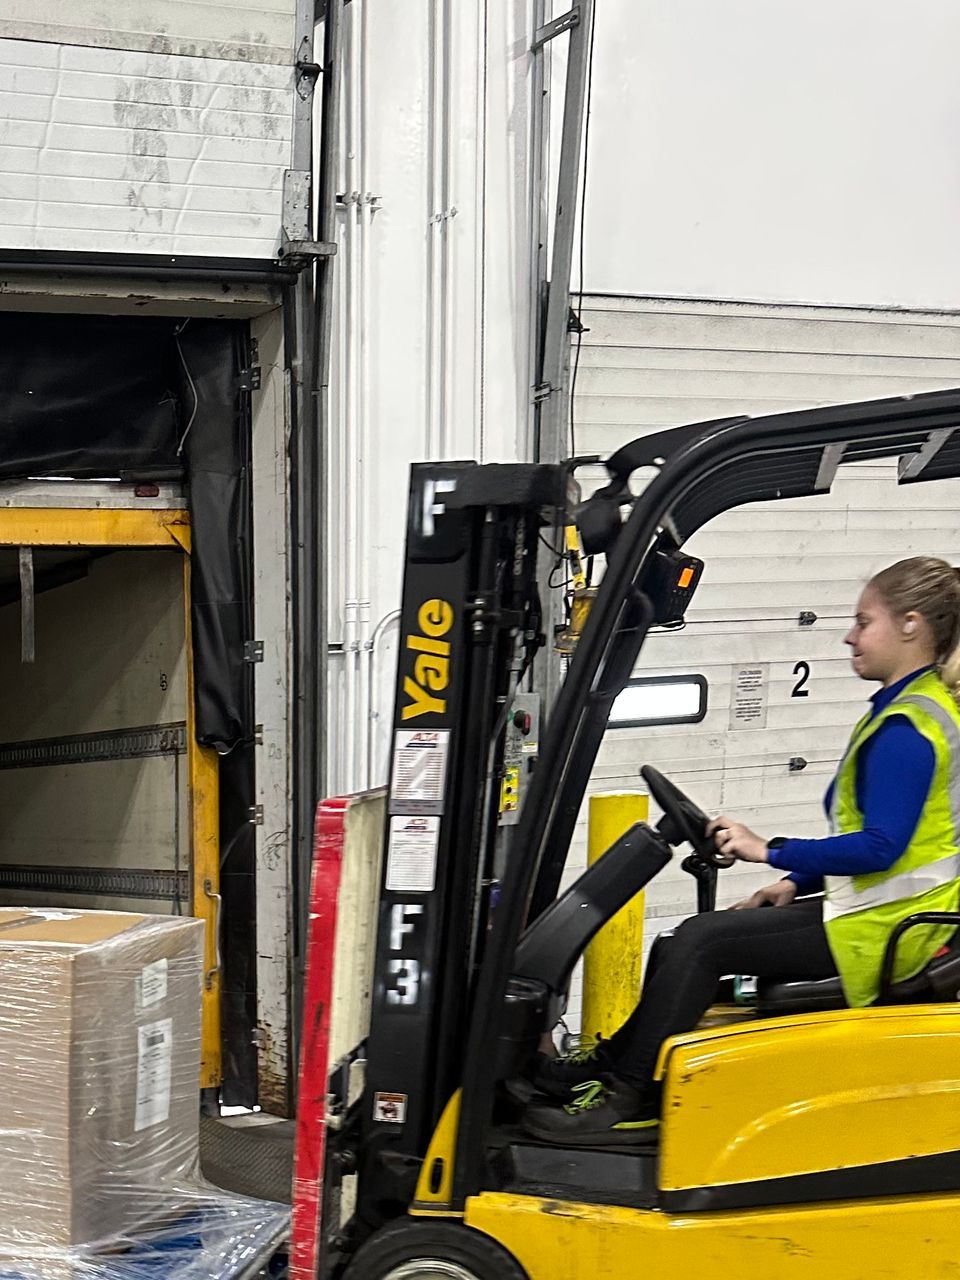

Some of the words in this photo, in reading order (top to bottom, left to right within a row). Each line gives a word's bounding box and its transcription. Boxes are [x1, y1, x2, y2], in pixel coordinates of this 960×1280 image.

[422, 480, 456, 537] F
[401, 598, 454, 720] Yale
[791, 660, 810, 697] 2
[390, 904, 424, 950] F
[387, 959, 420, 1005] 3
